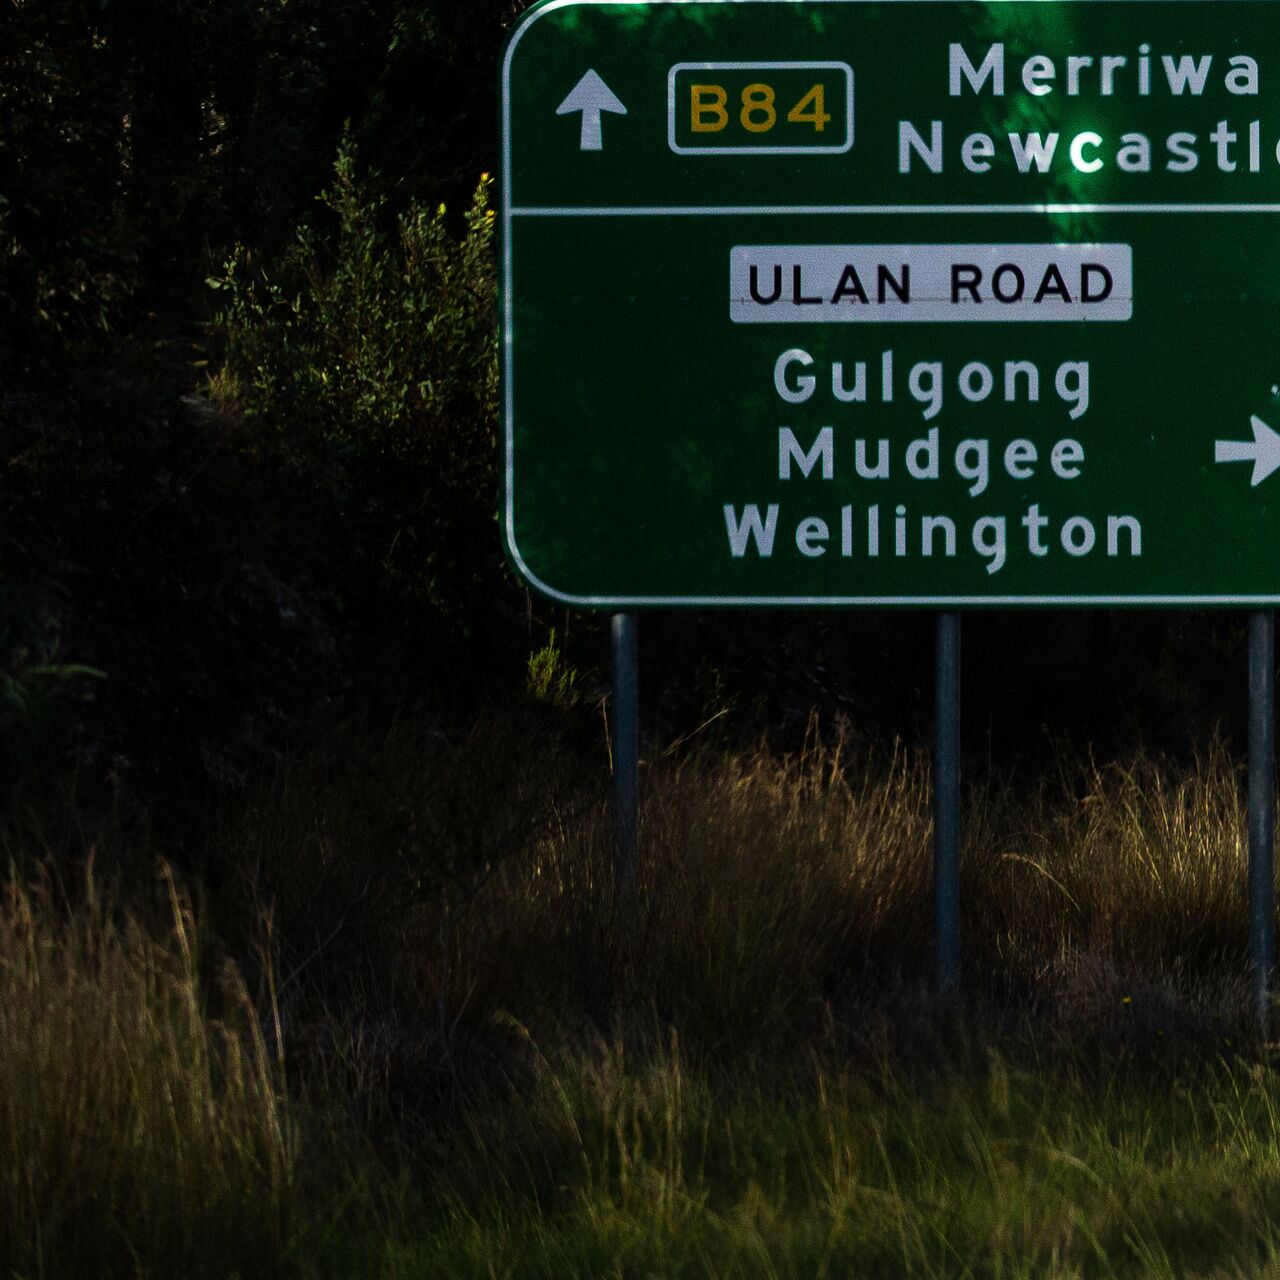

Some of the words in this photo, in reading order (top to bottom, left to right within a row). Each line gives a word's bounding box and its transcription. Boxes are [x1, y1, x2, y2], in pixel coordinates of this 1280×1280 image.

[949, 43, 1260, 97] Merriwa
[689, 83, 831, 133] B84
[748, 263, 913, 306] ULAN
[949, 262, 1115, 306] ROAD
[773, 348, 1090, 419] Gulgong
[778, 427, 1085, 497] Mudgee
[723, 504, 1143, 574] Wellington
